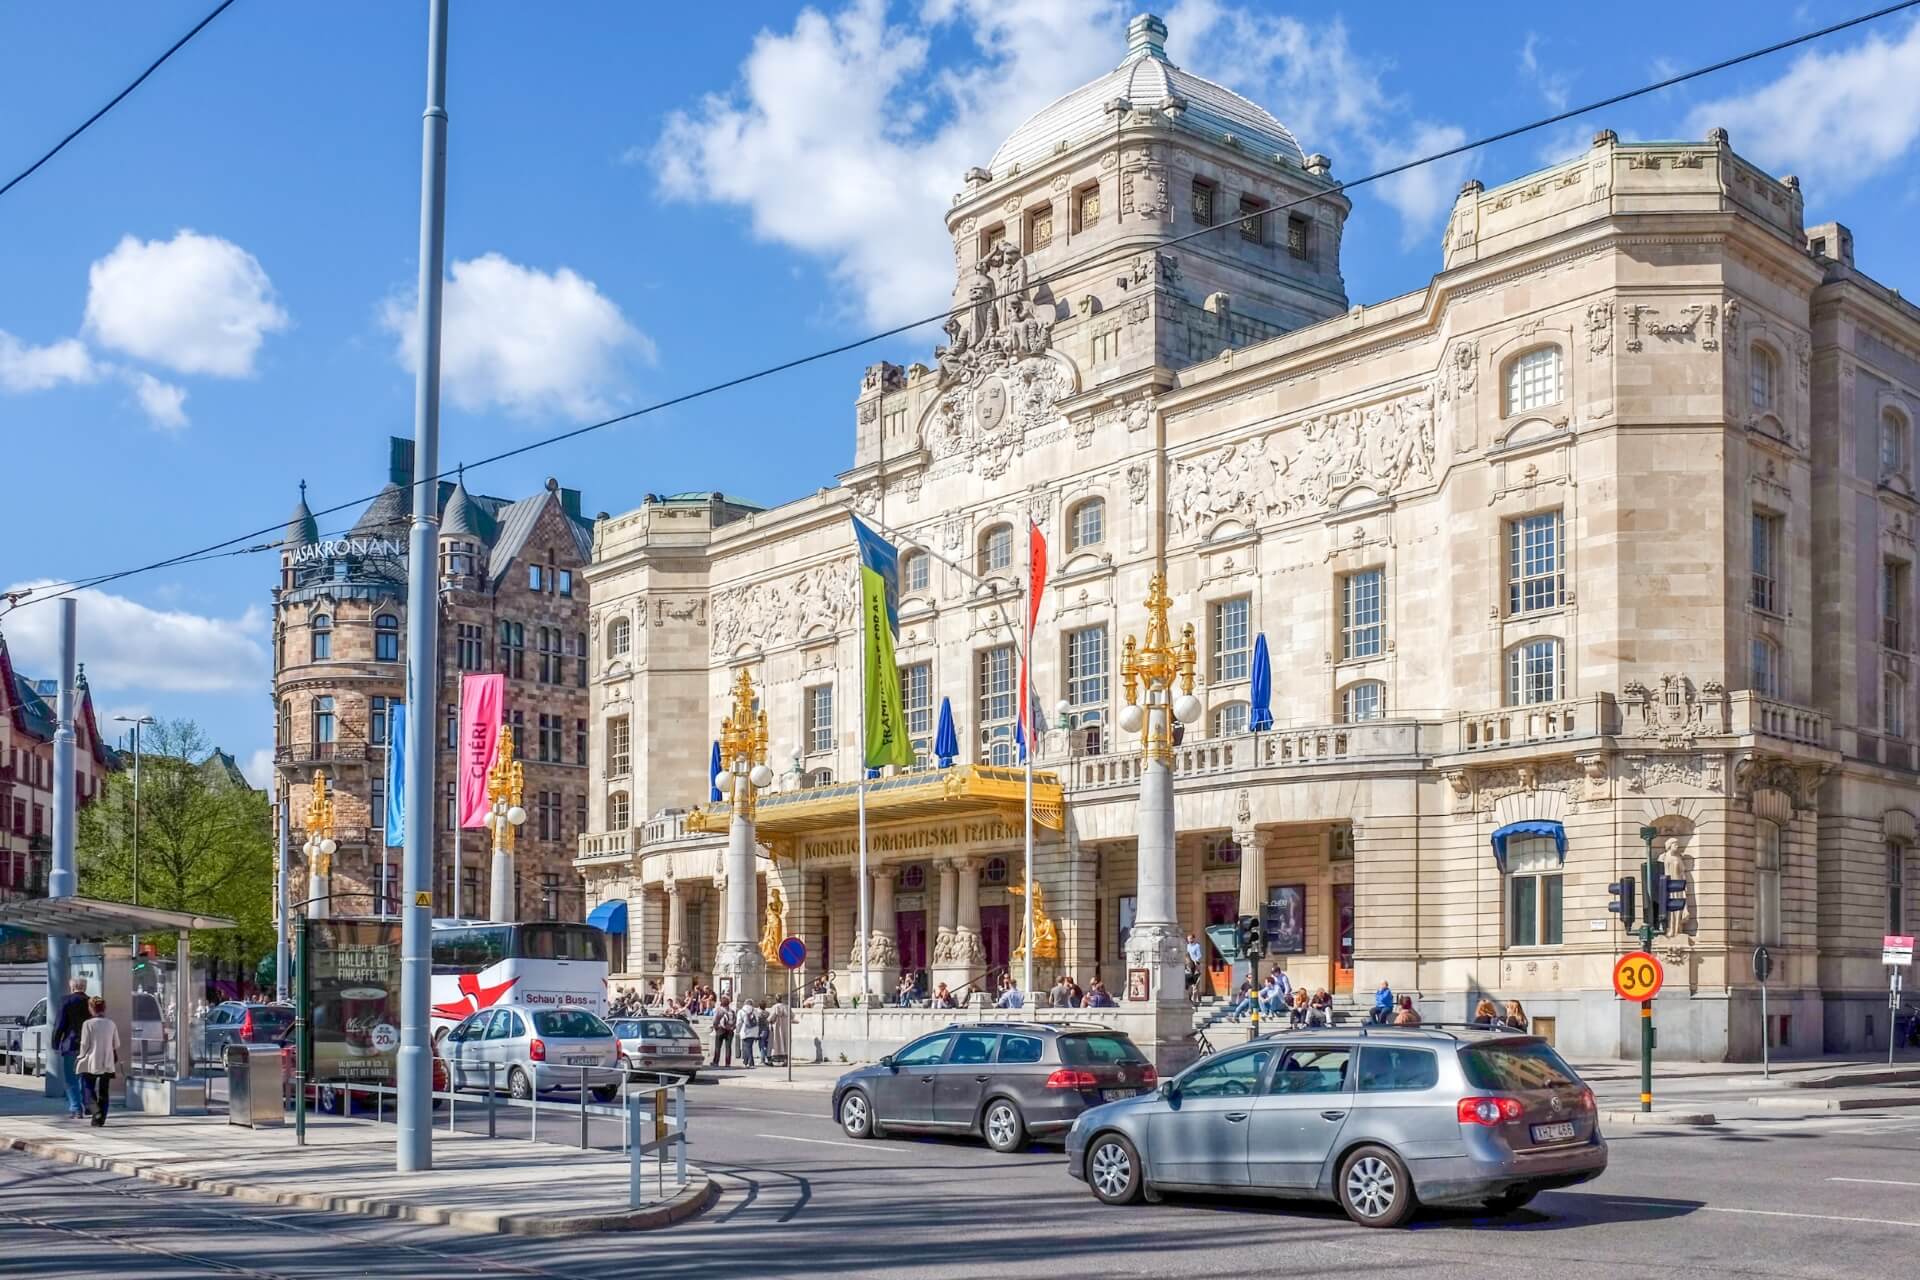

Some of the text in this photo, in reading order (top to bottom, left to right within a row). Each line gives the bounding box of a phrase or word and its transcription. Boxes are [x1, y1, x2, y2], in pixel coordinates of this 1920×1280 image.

[288, 539, 400, 564] VASAKRONAN
[468, 722, 487, 779] CHÉRI
[873, 826, 958, 851] DRAMATISKA
[1622, 964, 1655, 990] 30
[565, 995, 587, 1005] Buss
[376, 1034, 389, 1045] 20
